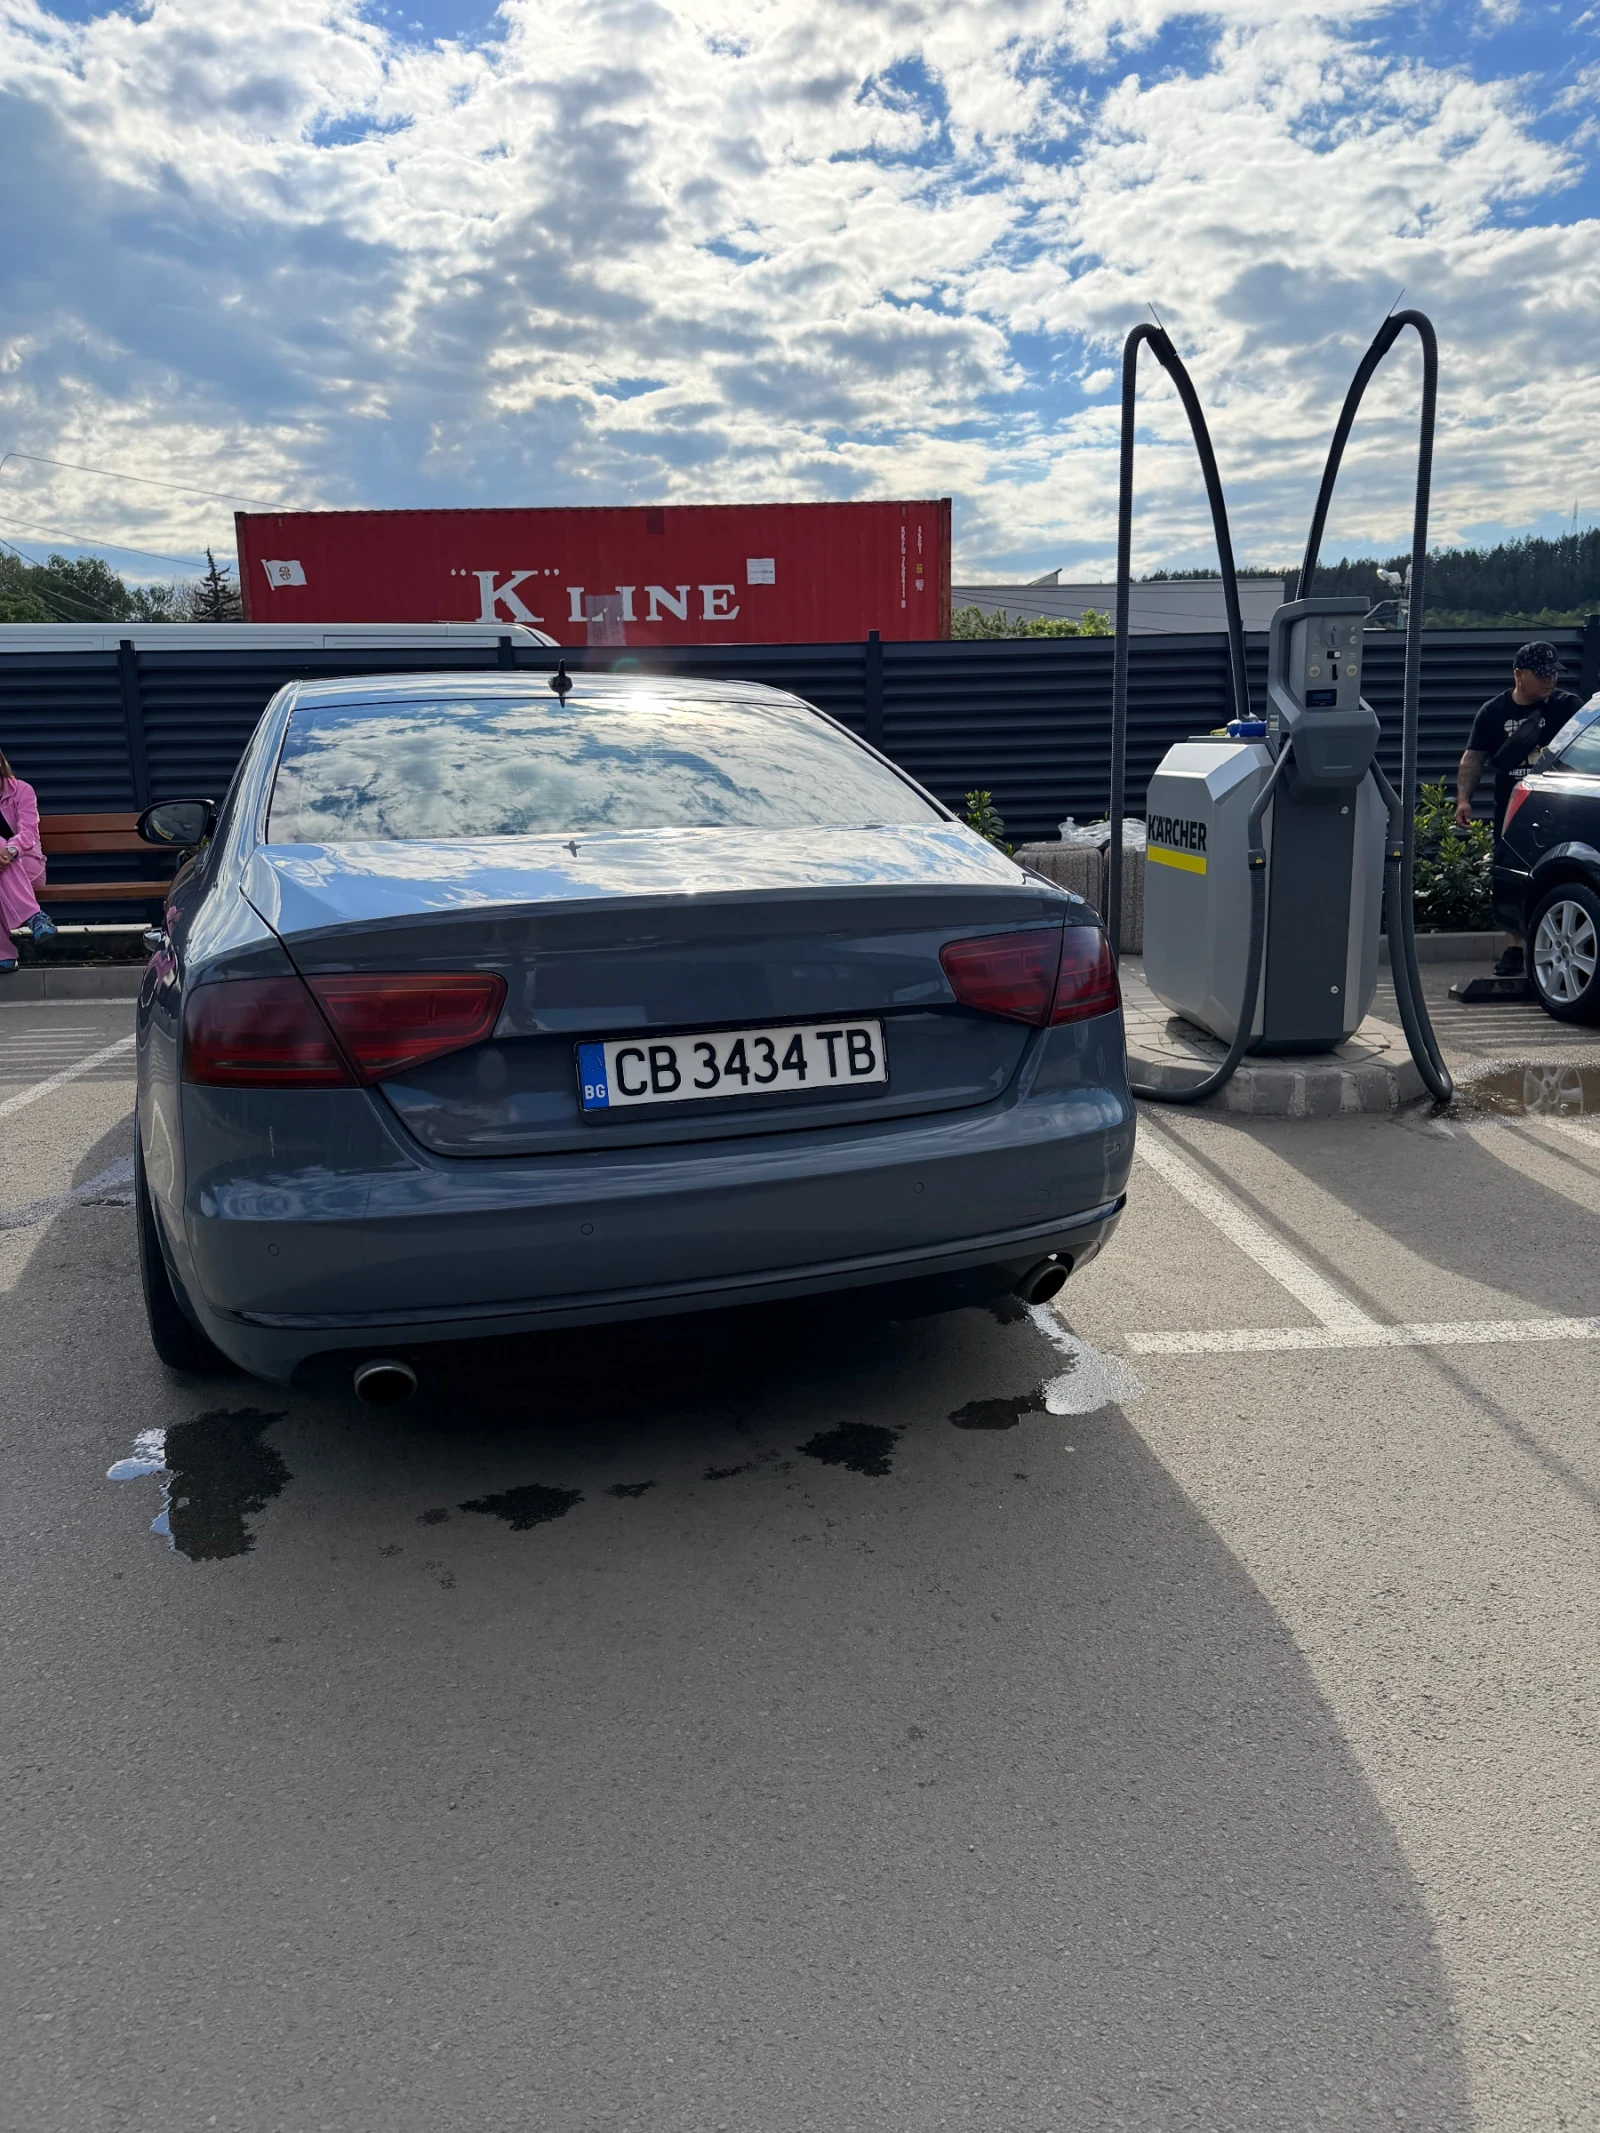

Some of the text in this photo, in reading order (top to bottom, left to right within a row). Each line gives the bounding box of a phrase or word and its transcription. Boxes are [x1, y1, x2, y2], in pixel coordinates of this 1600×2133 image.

[567, 585, 740, 622] LINE
[1148, 814, 1206, 852] KÄRCHER
[616, 1029, 876, 1097] CB 3434 TB
[584, 1085, 606, 1100] BG
